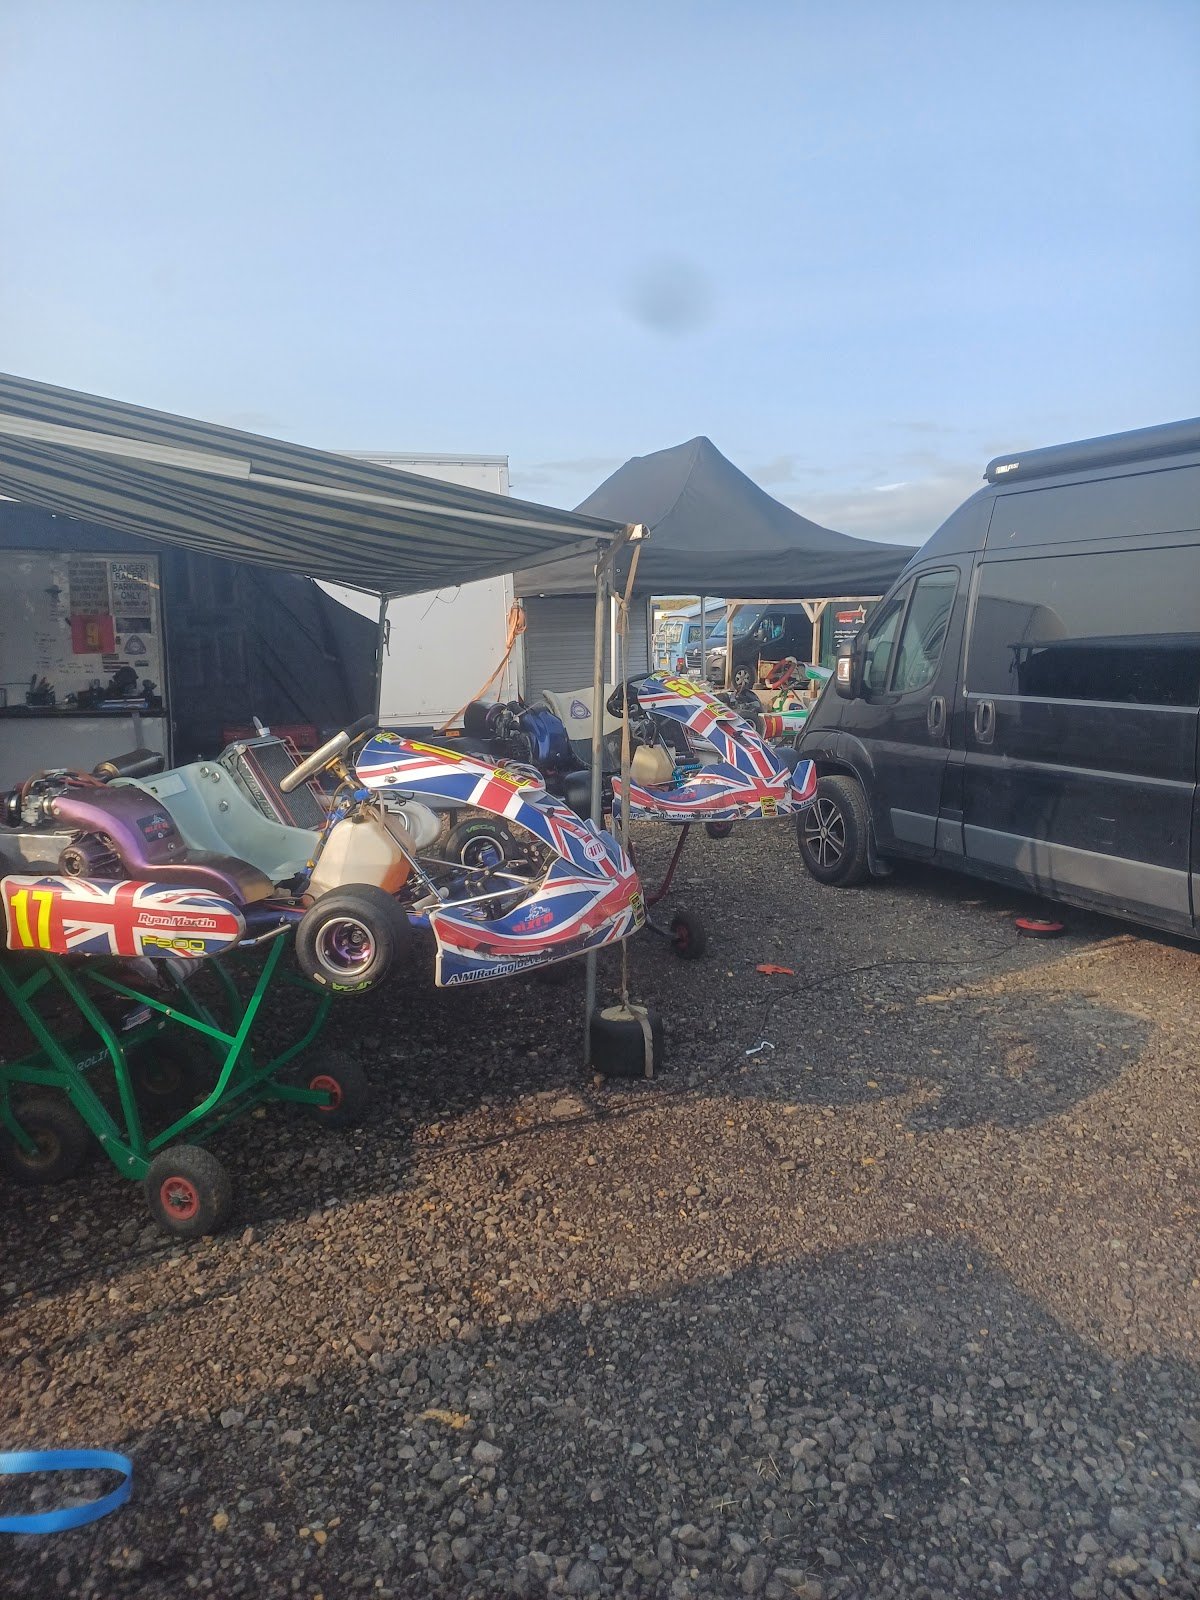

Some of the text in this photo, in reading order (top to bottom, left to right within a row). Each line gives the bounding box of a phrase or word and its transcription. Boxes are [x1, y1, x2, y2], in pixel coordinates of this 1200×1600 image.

[112, 564, 146, 573] BANGER
[113, 582, 148, 591] PARKING
[121, 591, 142, 599] ONLY
[10, 889, 53, 949] 17
[138, 913, 216, 928] Ryan Martin
